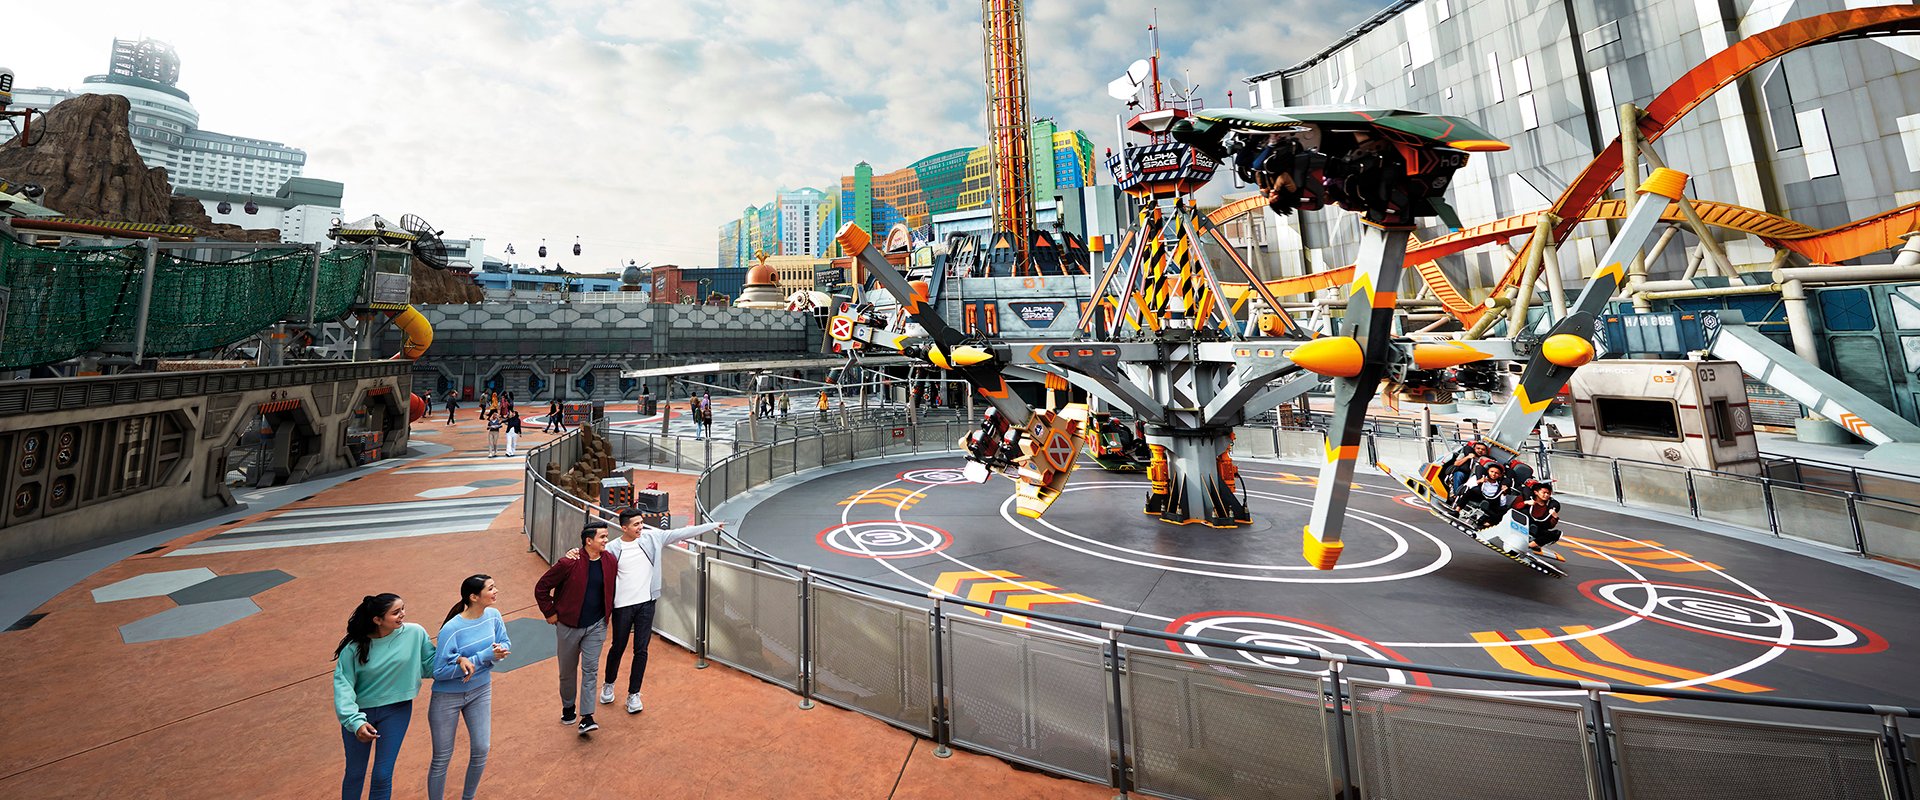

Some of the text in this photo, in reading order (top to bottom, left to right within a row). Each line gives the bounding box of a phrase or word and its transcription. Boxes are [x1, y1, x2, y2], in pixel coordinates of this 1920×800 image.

[1142, 152, 1177, 162] ALPHA
[1142, 159, 1177, 169] SPACE
[1196, 159, 1214, 168] SPACE
[1023, 277, 1045, 289] 01
[1653, 375, 1675, 383] 03
[1700, 368, 1716, 382] 03
